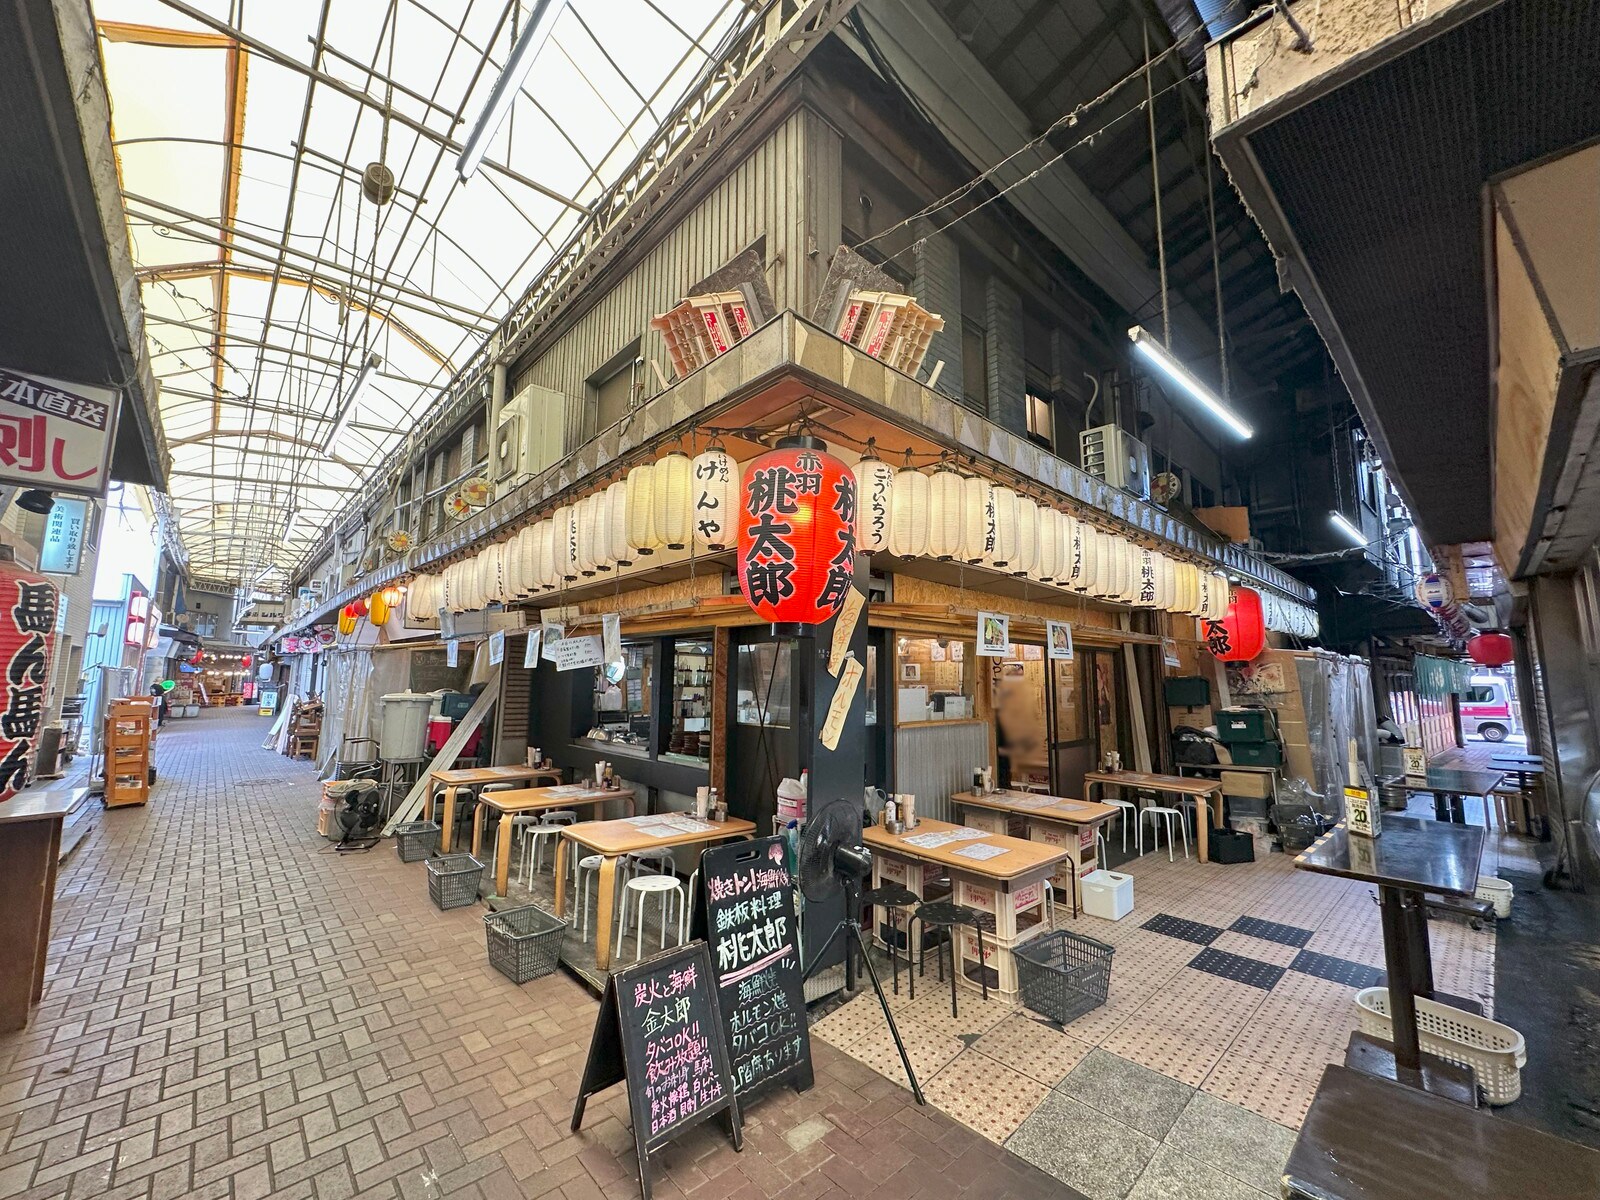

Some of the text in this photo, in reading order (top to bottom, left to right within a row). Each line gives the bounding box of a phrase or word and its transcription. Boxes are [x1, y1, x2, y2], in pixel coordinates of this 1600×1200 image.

[0, 371, 104, 428] 本直送
[718, 453, 730, 483] いけめん
[796, 452, 822, 495] 赤羽
[696, 460, 721, 538] けんや
[871, 468, 887, 545] こういちろう
[50, 505, 65, 543] 美術関連品
[64, 517, 81, 569] 買い取り致します
[746, 466, 799, 607] 桃太郎
[824, 664, 858, 743] ホルモン
[1354, 808, 1367, 823] 20
[715, 890, 784, 933] 鉄板料理
[716, 916, 788, 971] 桃太郎
[971, 945, 992, 960] Ashi
[634, 963, 698, 1008] 炭火と海鮮
[641, 996, 691, 1039] 金太郎
[729, 990, 789, 1034] ホルモン焼
[646, 1020, 700, 1066] タバコOK!!
[646, 1037, 708, 1085] 飲み放題!!
[651, 1107, 677, 1136] 日本酒
